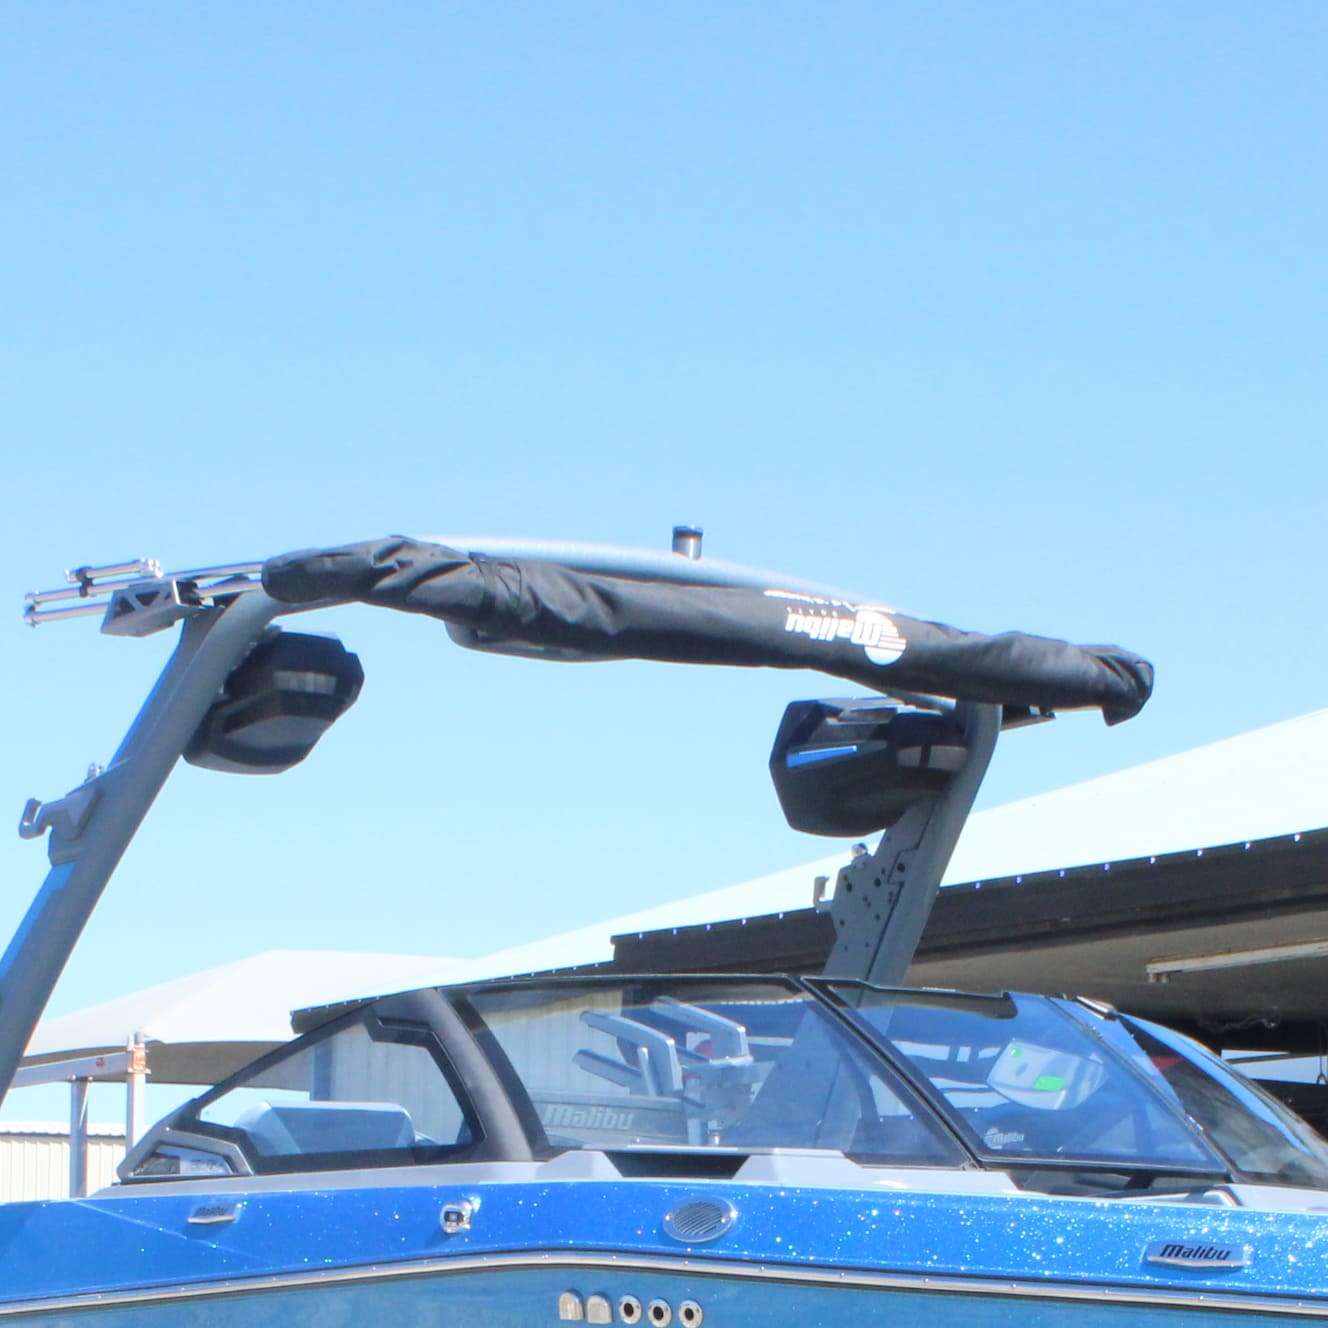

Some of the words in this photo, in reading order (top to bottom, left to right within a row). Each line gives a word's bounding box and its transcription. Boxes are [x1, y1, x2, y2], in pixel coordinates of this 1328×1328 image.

[784, 613, 881, 646] Malibu
[543, 1104, 635, 1130] Malibu
[1160, 1244, 1231, 1260] Malibu
